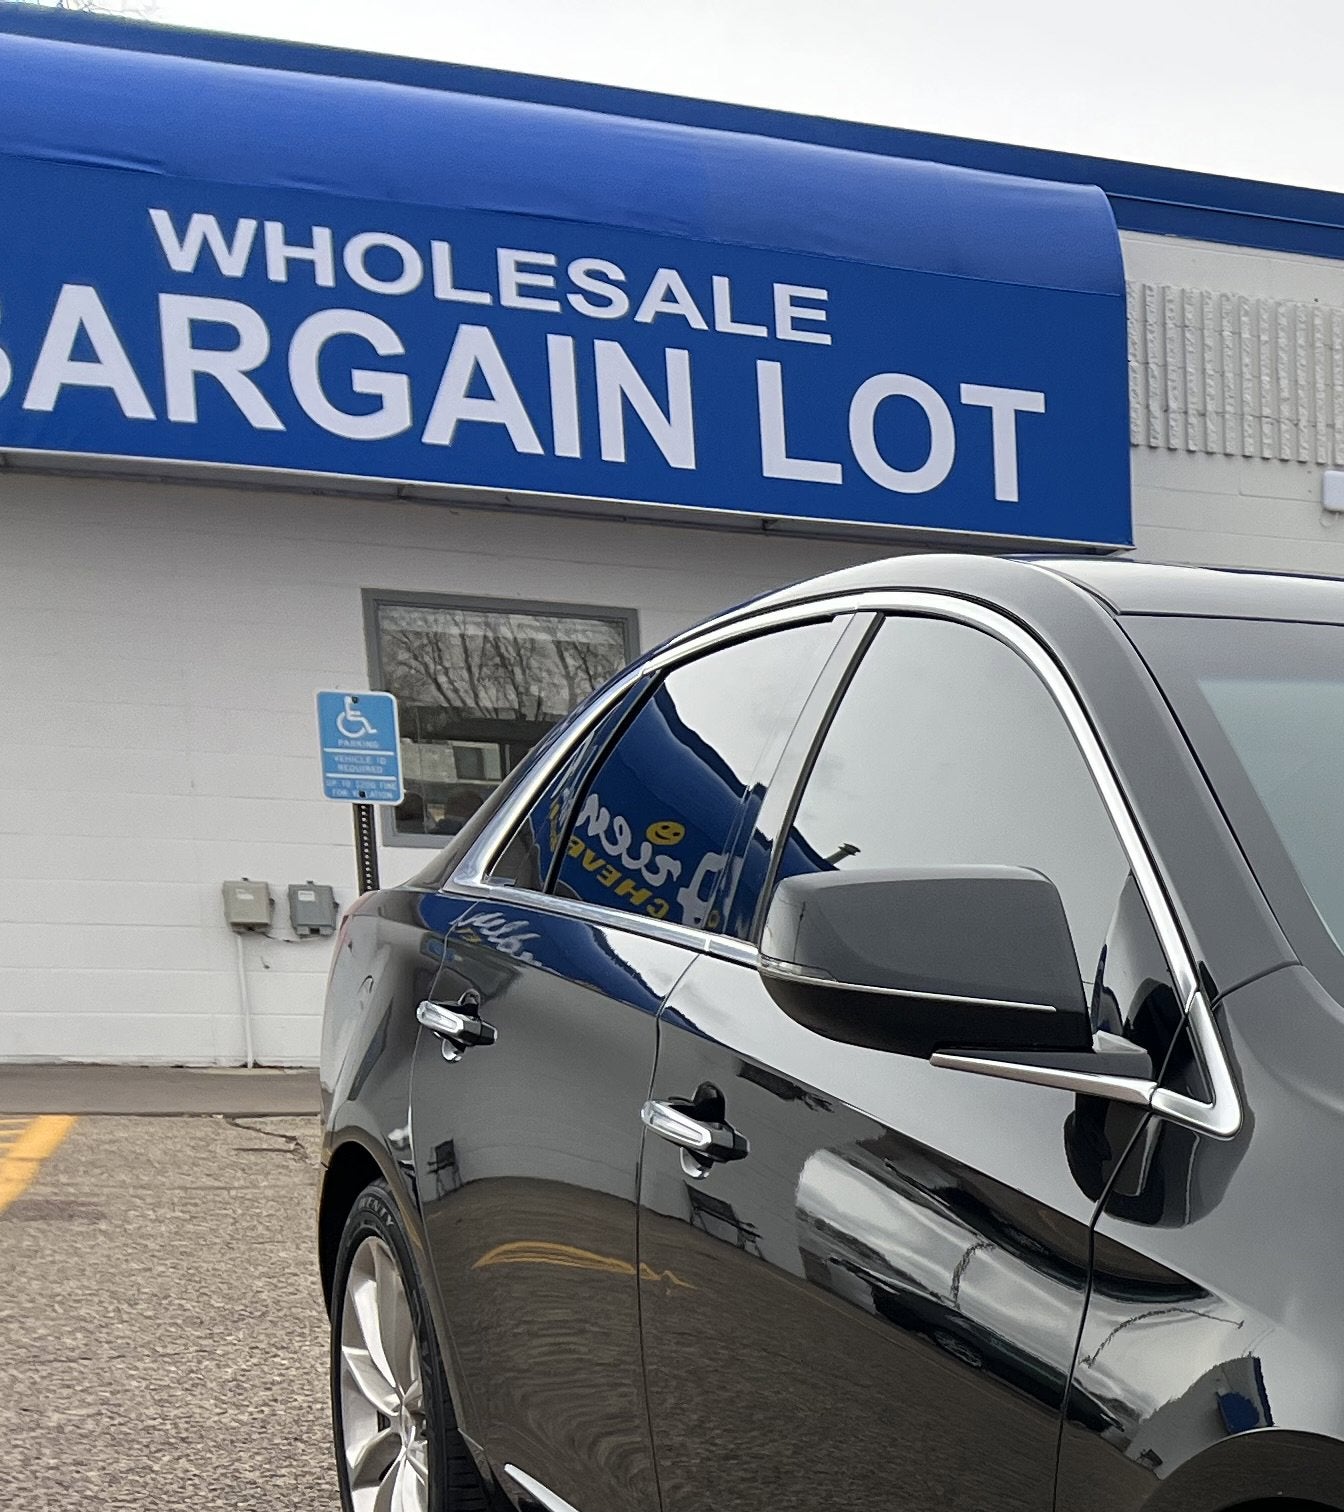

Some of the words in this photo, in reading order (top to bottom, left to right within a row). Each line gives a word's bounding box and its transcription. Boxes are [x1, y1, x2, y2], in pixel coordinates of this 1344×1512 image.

[146, 208, 833, 346] WHOLESALE
[0, 283, 697, 471] ARGAIN
[756, 358, 1046, 502] LOT
